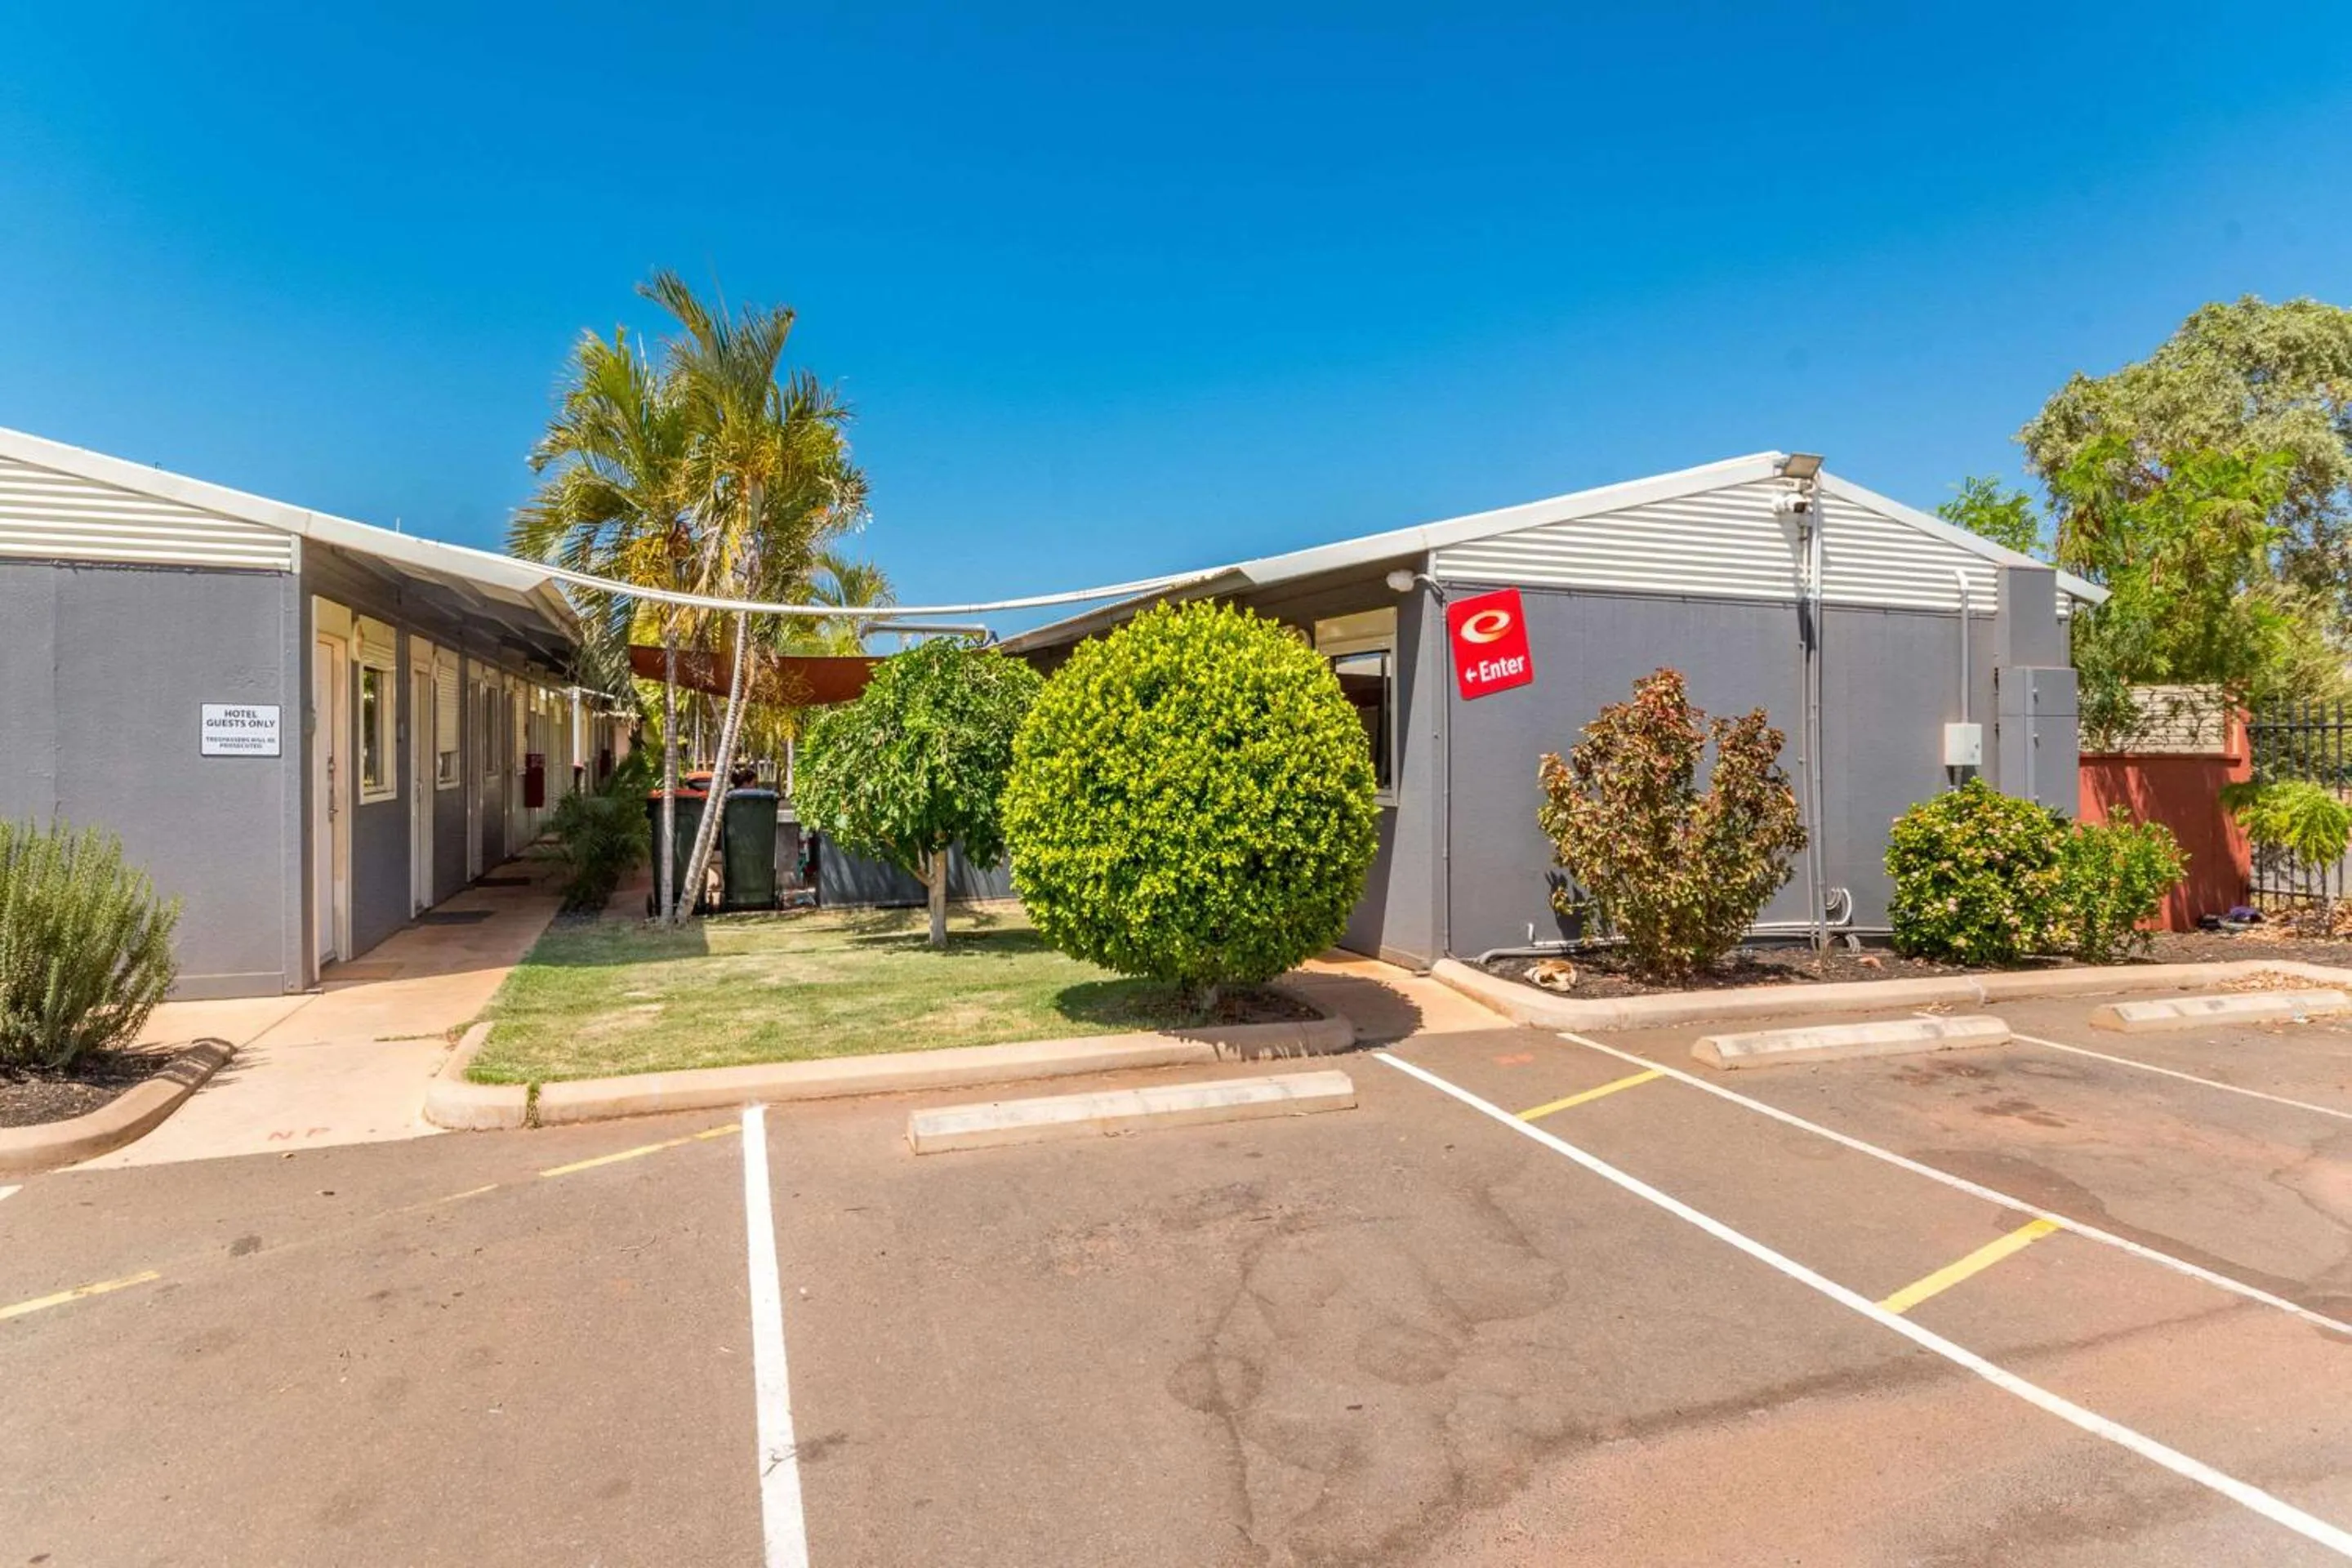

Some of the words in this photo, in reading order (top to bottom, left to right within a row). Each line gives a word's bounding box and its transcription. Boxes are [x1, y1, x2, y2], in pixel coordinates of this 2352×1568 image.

[1478, 655, 1525, 682] Enter
[225, 710, 256, 718] HOTEL
[206, 719, 246, 728] GUESTS
[248, 719, 275, 728] ONLY
